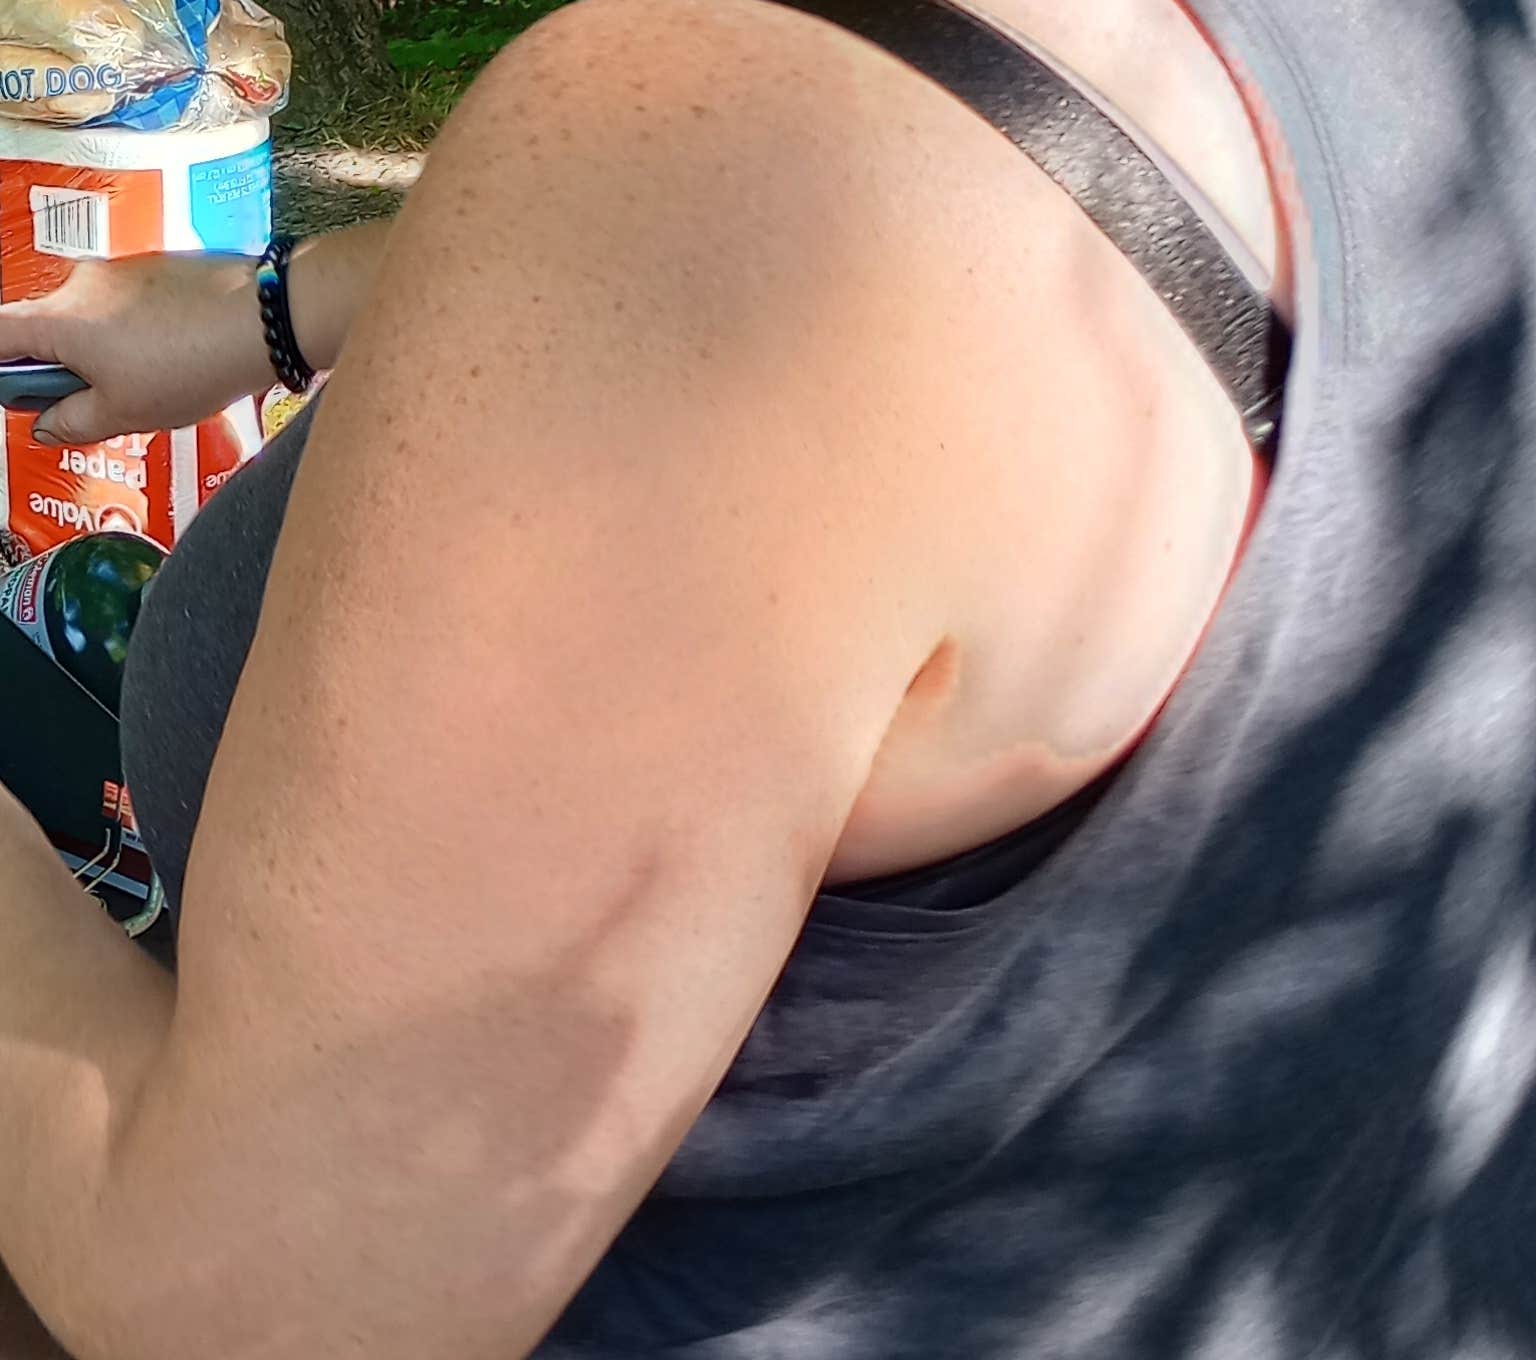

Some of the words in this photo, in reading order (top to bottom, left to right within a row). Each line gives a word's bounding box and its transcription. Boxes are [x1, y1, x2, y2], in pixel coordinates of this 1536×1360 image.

[46, 64, 123, 98] DOG
[59, 448, 148, 490] Paper
[29, 492, 95, 532] Value
